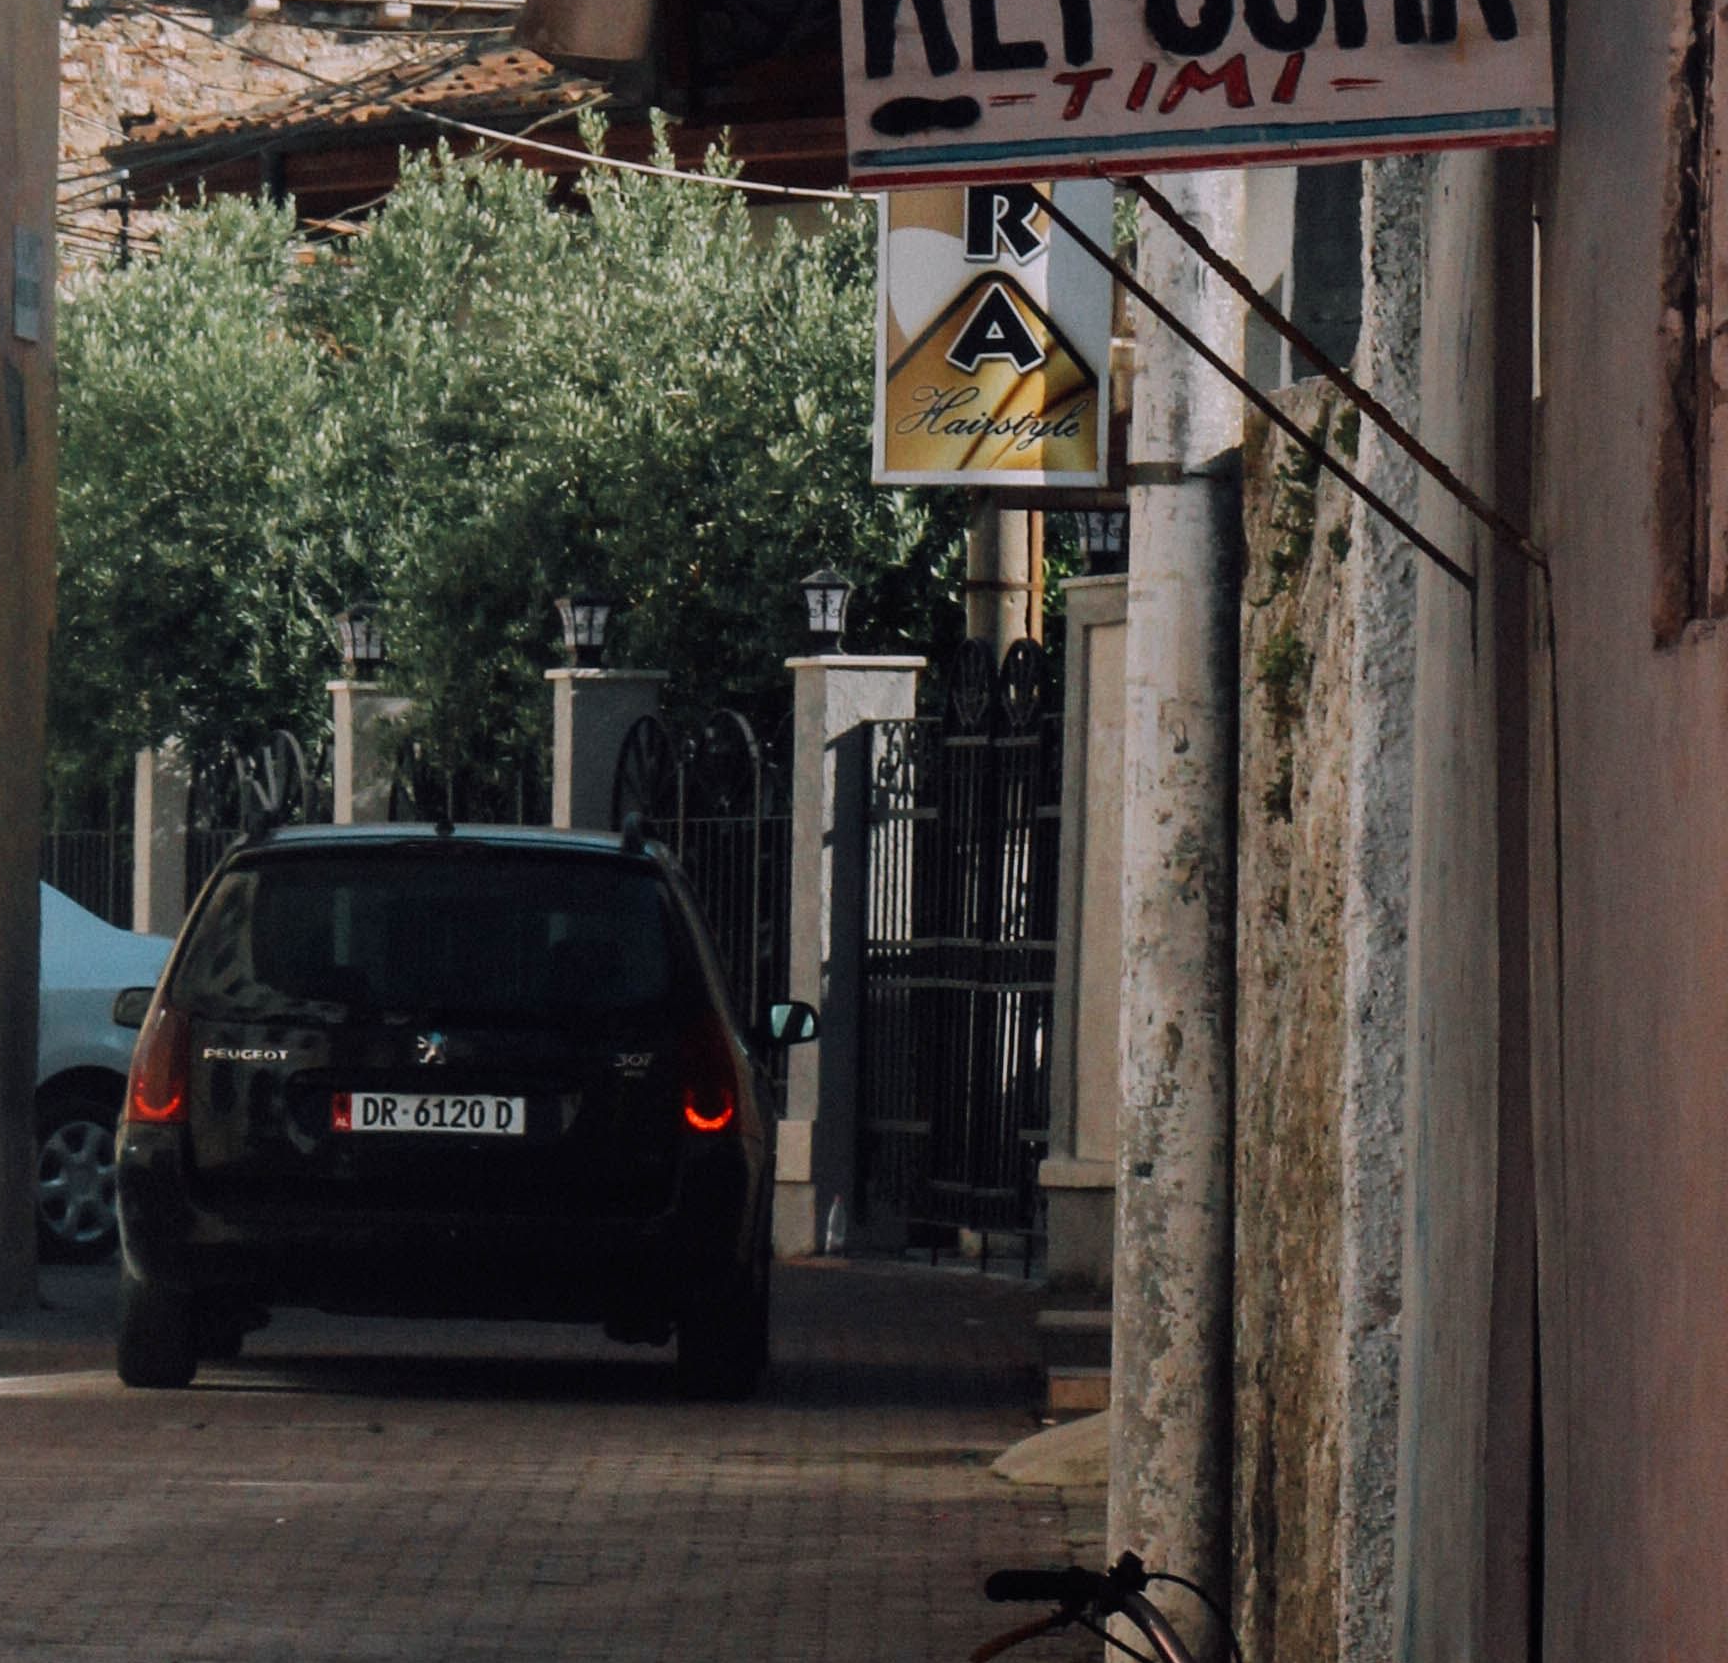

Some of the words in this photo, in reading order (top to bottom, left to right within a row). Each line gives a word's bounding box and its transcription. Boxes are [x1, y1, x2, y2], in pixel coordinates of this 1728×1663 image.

[1053, 51, 1305, 121] TIMI
[895, 385, 1090, 451] Hairstyle
[203, 1047, 289, 1060] PEUGEOT
